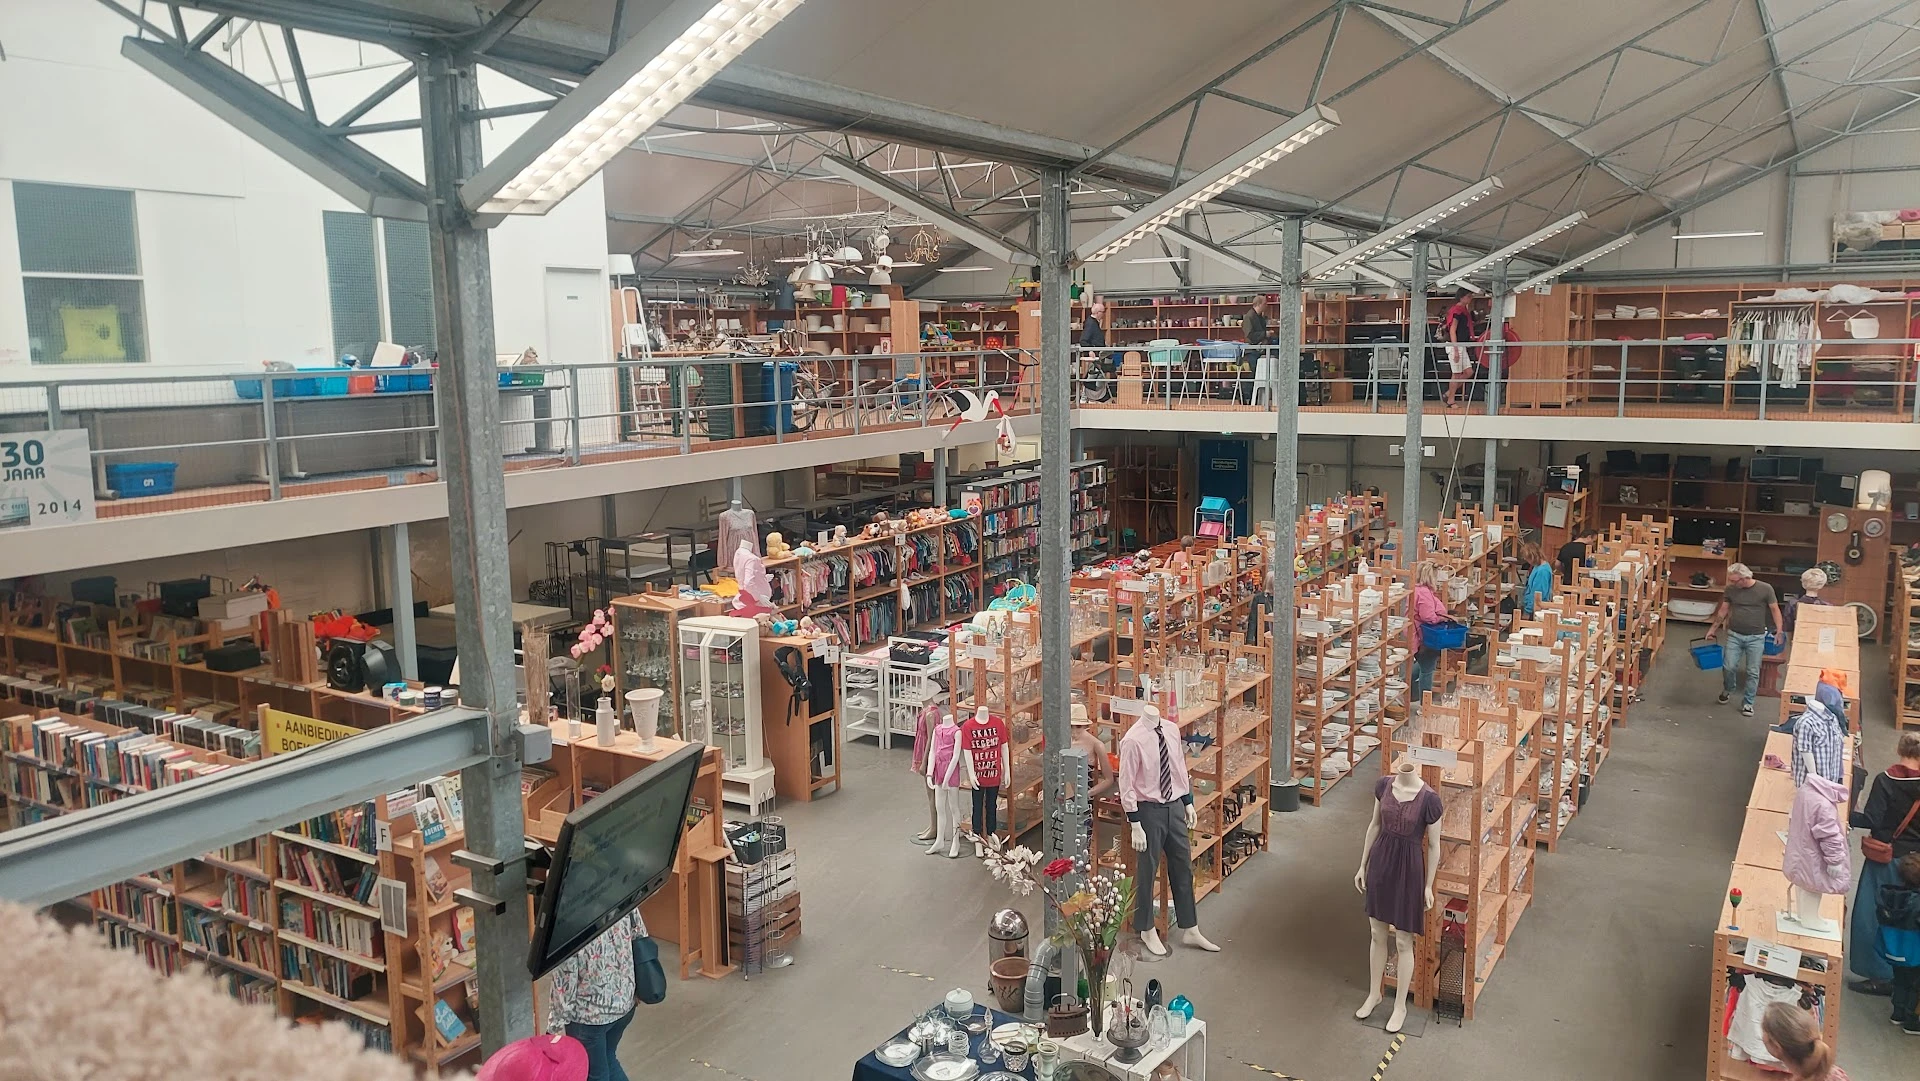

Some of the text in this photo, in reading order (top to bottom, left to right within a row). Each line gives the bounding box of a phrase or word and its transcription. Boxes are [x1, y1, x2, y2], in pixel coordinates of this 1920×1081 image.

[1, 440, 44, 467] 30
[3, 467, 45, 482] JAAR
[38, 499, 81, 515] 2014
[972, 728, 997, 738] SKATE
[380, 828, 387, 844] F
[424, 823, 444, 837] ADEMEN
